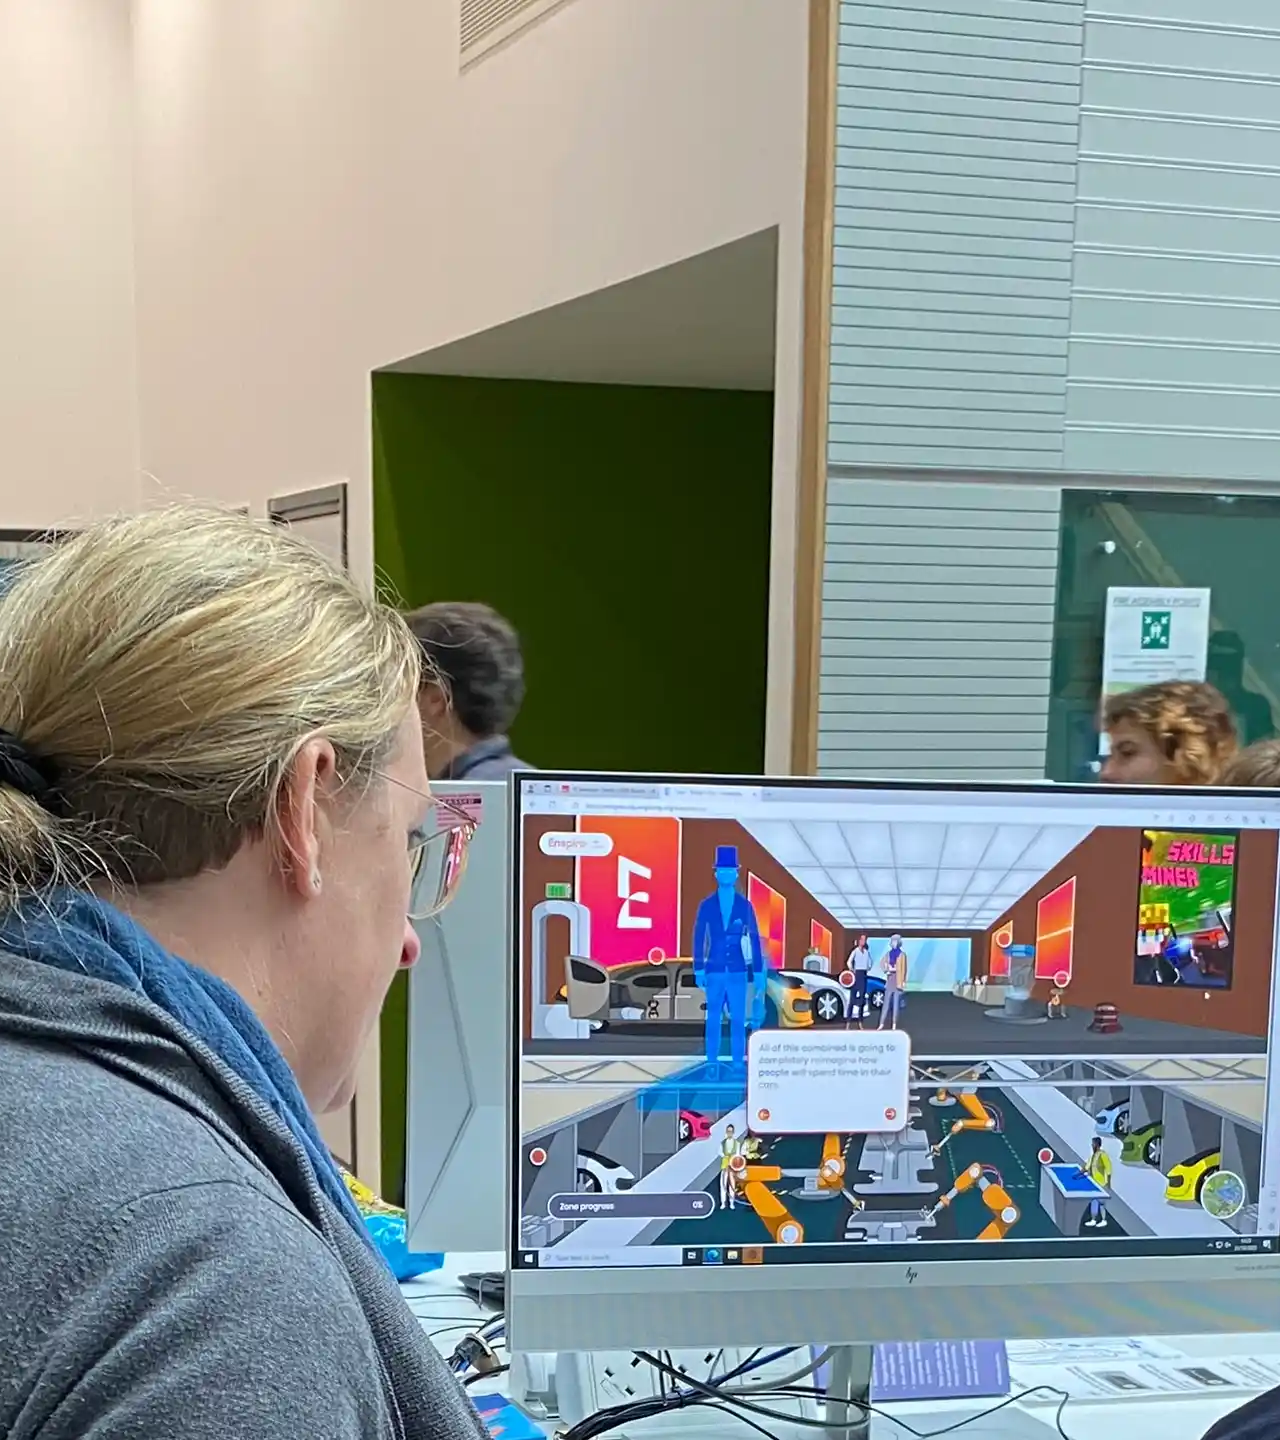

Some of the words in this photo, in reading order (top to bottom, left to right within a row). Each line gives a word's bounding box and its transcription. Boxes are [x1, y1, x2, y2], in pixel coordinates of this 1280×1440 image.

[1168, 841, 1234, 865] SKILLS
[1142, 865, 1199, 888] MINER
[771, 1044, 782, 1052] of
[783, 1044, 799, 1052] this
[801, 1044, 847, 1052] combined
[858, 1044, 884, 1054] going
[886, 1044, 896, 1052] to
[858, 1056, 877, 1064] how
[758, 1068, 789, 1078] people
[808, 1068, 836, 1078] spend
[838, 1068, 858, 1076] time
[559, 1202, 579, 1211] Zone
[580, 1202, 615, 1213] progress
